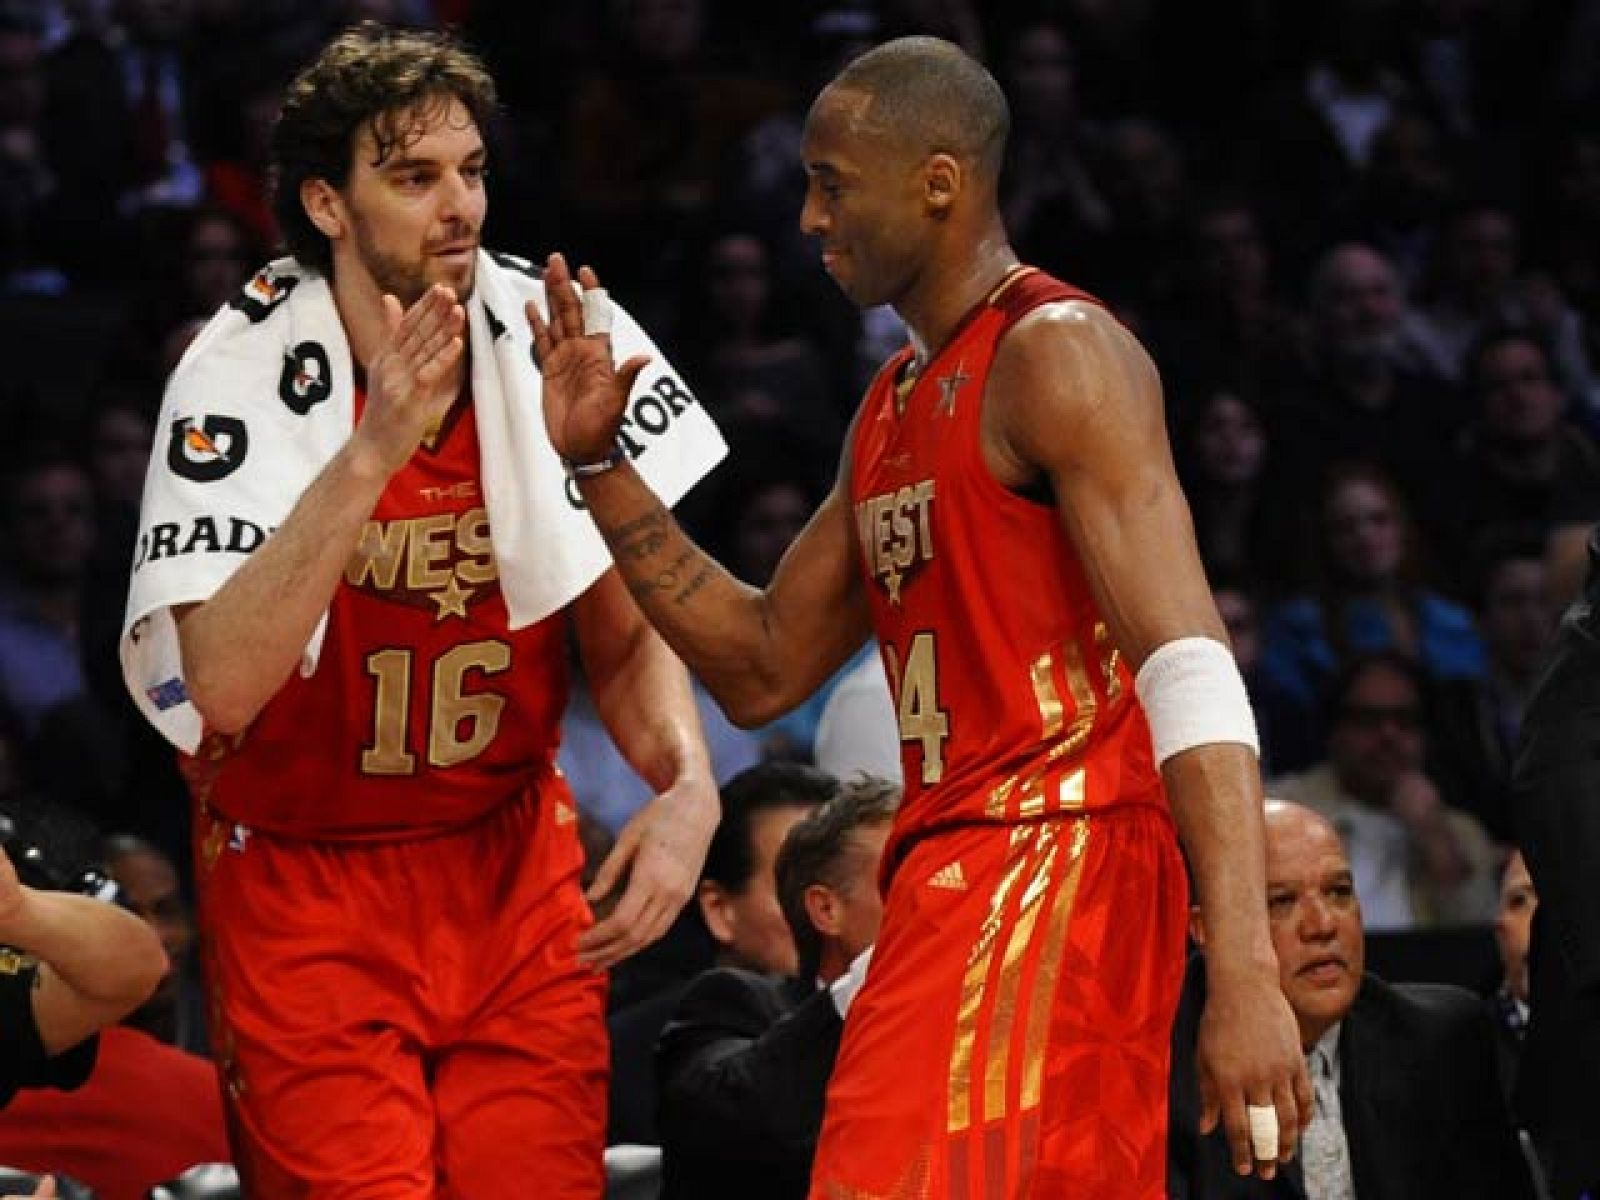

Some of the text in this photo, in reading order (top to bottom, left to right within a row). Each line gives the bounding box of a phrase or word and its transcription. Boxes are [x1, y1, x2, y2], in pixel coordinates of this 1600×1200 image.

[134, 515, 279, 573] RAD
[348, 508, 497, 590] WES
[362, 640, 511, 775] 16
[886, 634, 949, 783] 4
